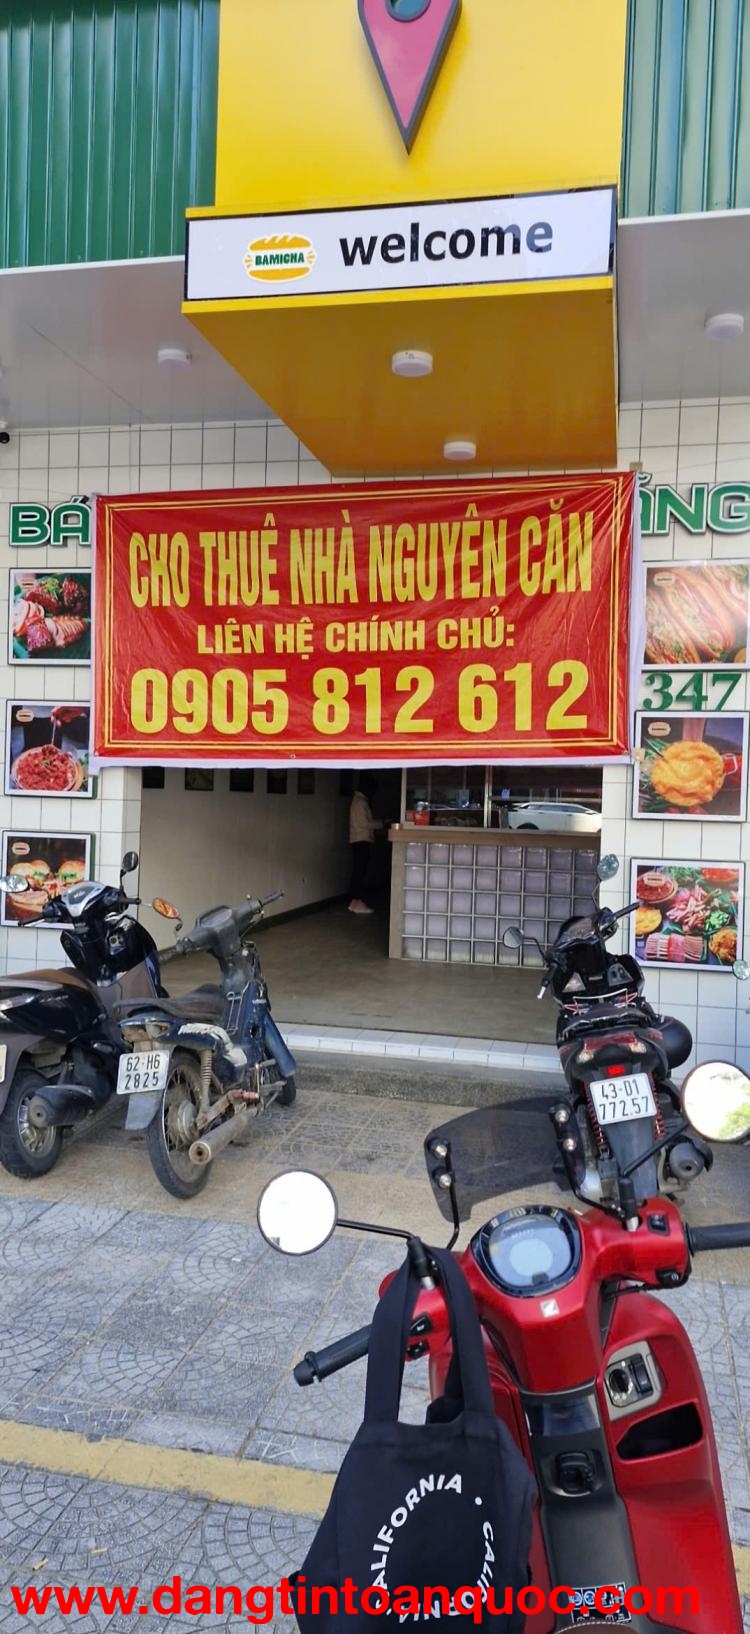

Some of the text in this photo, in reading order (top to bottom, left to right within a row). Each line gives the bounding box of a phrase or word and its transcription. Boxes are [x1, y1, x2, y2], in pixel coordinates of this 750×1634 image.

[254, 252, 305, 266] BAMICHA
[339, 220, 554, 268] welcome
[10, 495, 91, 546] BÁ
[129, 497, 594, 608] CHO THUÊ NHÀ NGUYÊN CĂN
[197, 606, 515, 660] LIÊN HỆ CHÍNH CHỦ:
[129, 659, 589, 735] 0905 812 612
[642, 671, 742, 712] 347
[124, 1072, 160, 1090] 2825
[599, 1096, 649, 1121] 772.57
